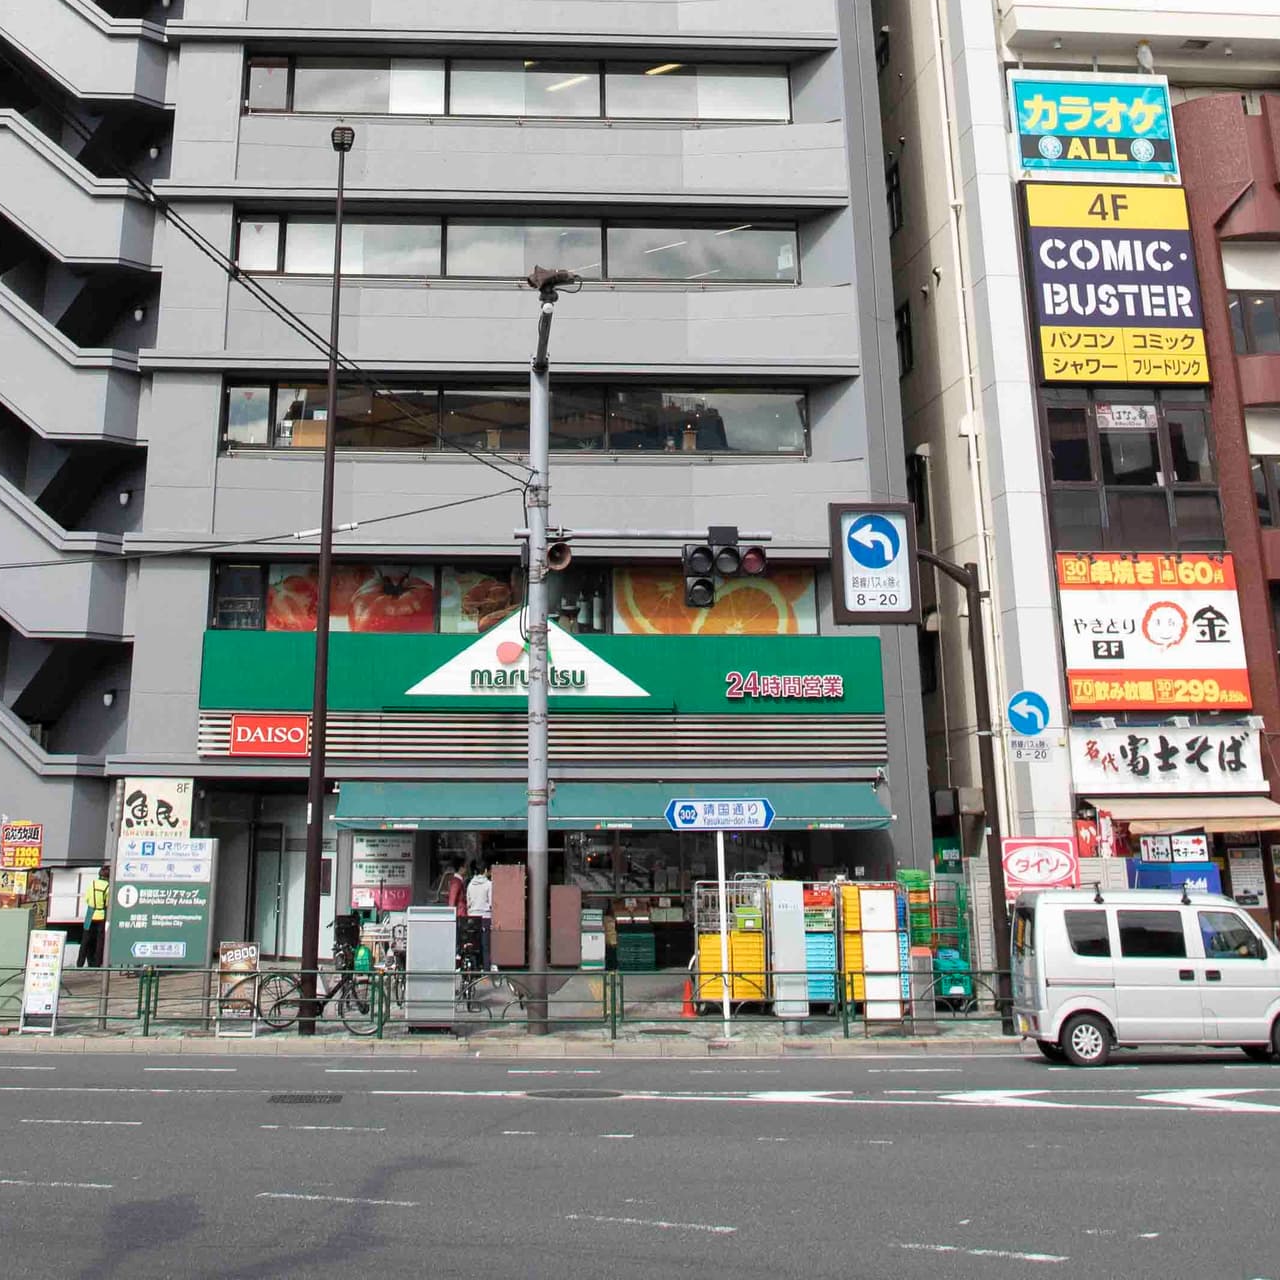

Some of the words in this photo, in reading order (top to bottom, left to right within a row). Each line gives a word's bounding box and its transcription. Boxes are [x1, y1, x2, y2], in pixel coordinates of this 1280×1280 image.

[1022, 94, 1163, 133] カラオケ
[1067, 137, 1128, 161] ALL
[1087, 194, 1129, 222] 4F
[1042, 283, 1194, 318] BUSTER
[1051, 331, 1115, 349] パソコン
[1132, 333, 1195, 350] コミック
[1053, 358, 1118, 375] シャワー
[1132, 359, 1201, 376] フリードリンク
[1065, 561, 1087, 577] 30
[1090, 561, 1155, 584] 串焼き
[856, 593, 898, 606] 8-20
[1192, 605, 1232, 643] 金
[1096, 641, 1120, 657] 2F
[470, 666, 586, 688] marutsu
[726, 670, 844, 700] 24時間営業
[235, 725, 305, 746] DAISO
[1084, 738, 1119, 773] 名代
[1119, 731, 1251, 777] 富士そば
[176, 782, 191, 794] 8F
[125, 789, 180, 829] 魚民
[680, 809, 697, 820] 302
[703, 803, 759, 817] 靖国通り
